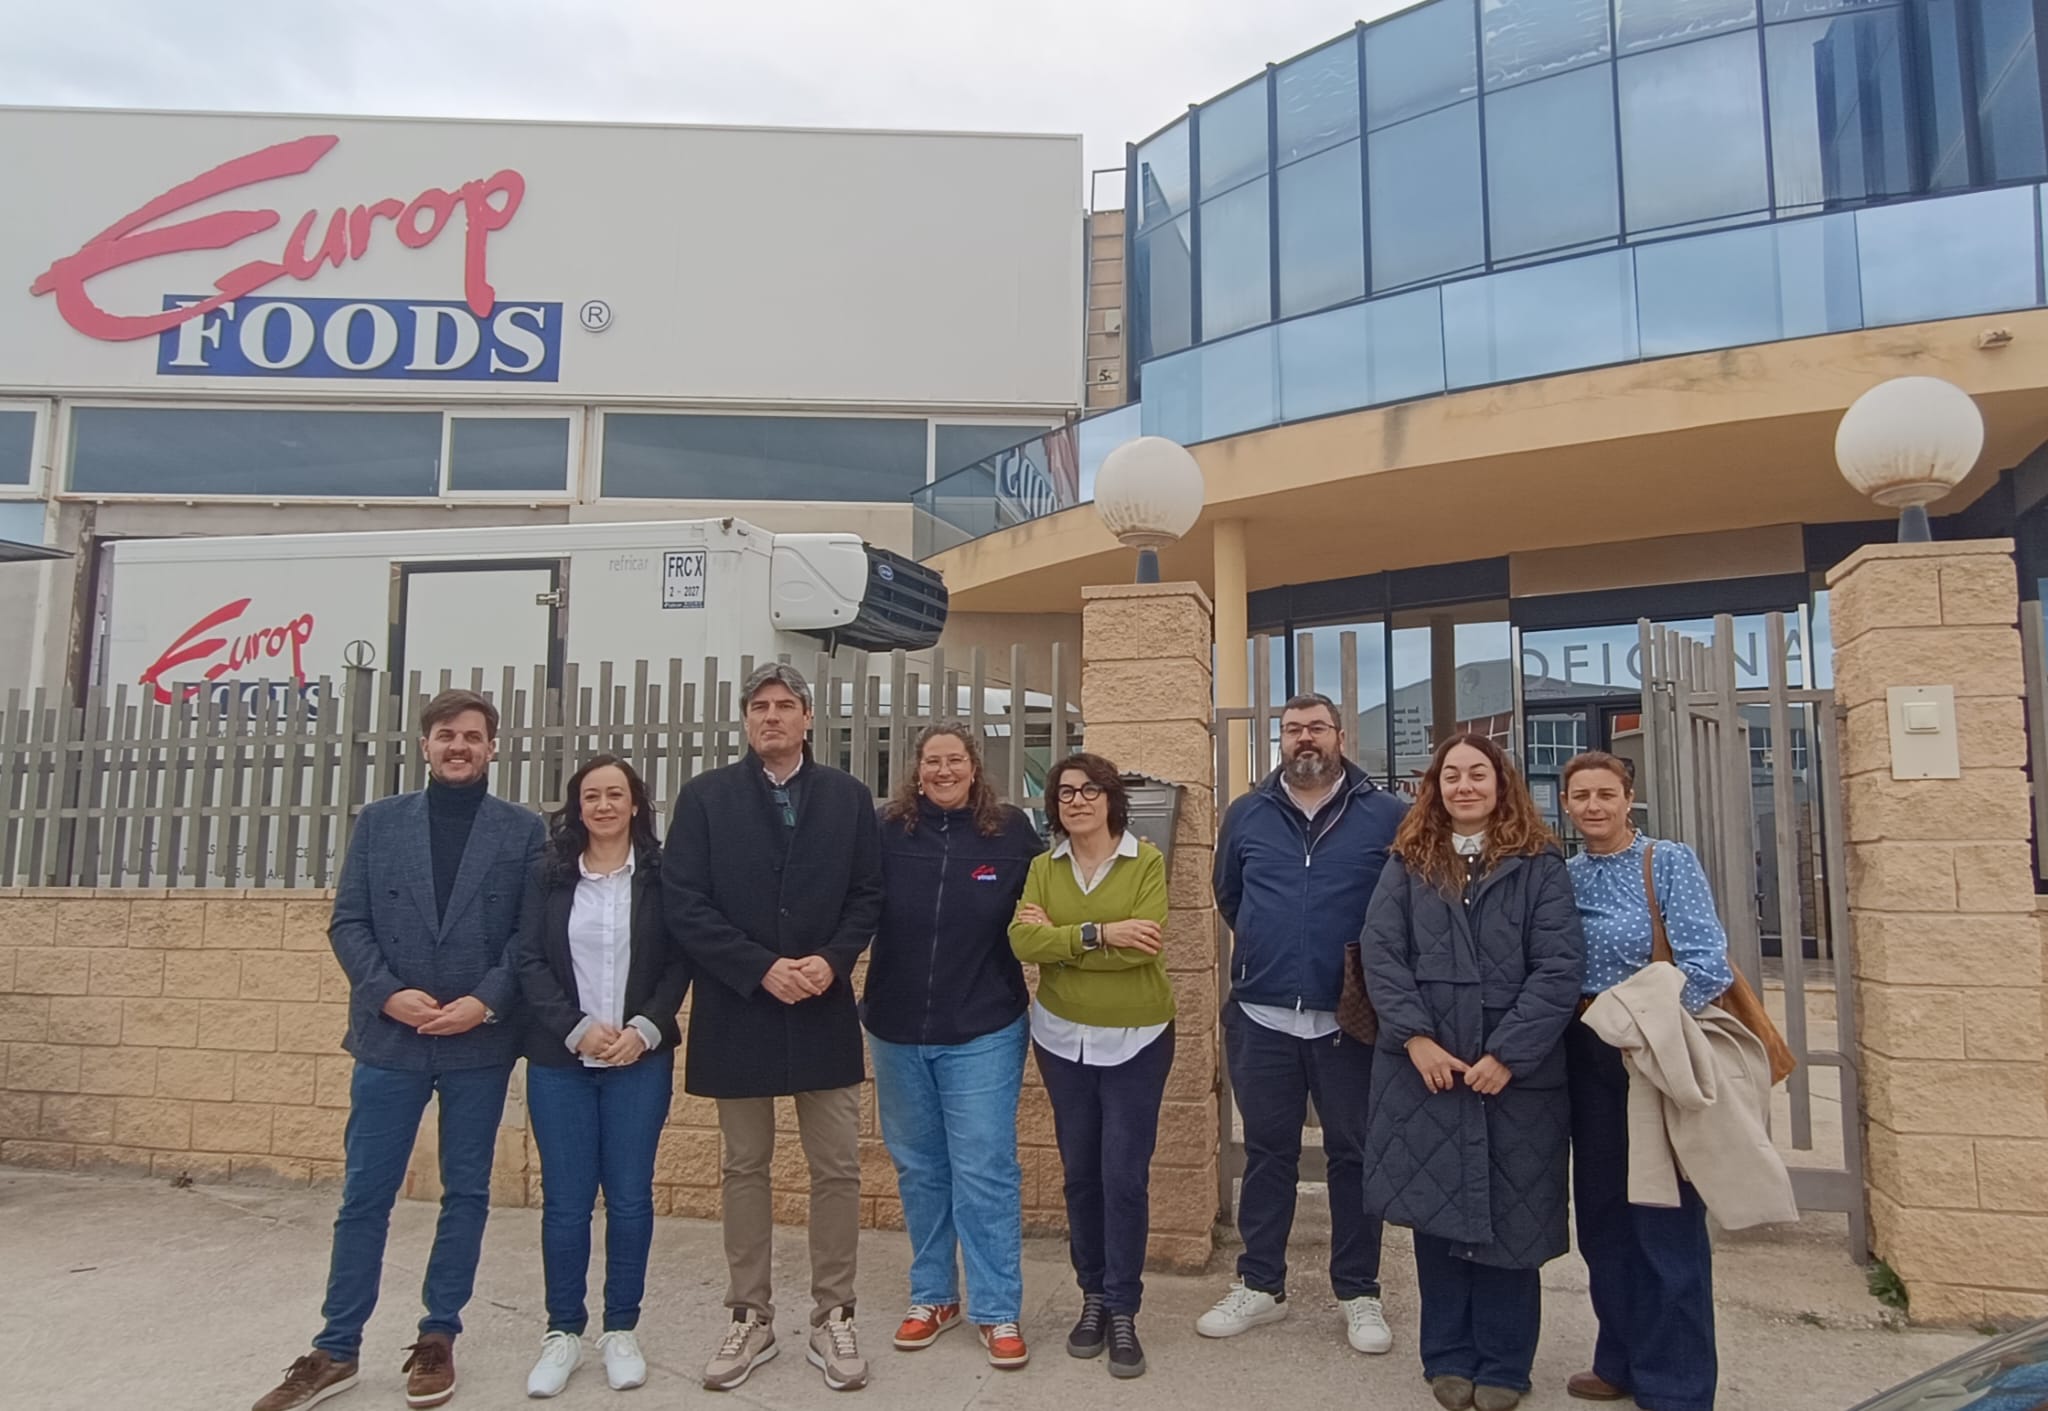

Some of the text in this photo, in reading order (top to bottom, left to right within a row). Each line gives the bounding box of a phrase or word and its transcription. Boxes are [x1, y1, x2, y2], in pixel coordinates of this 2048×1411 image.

[30, 135, 525, 341] Europ
[168, 301, 548, 375] FOODS
[138, 598, 314, 706] Europ
